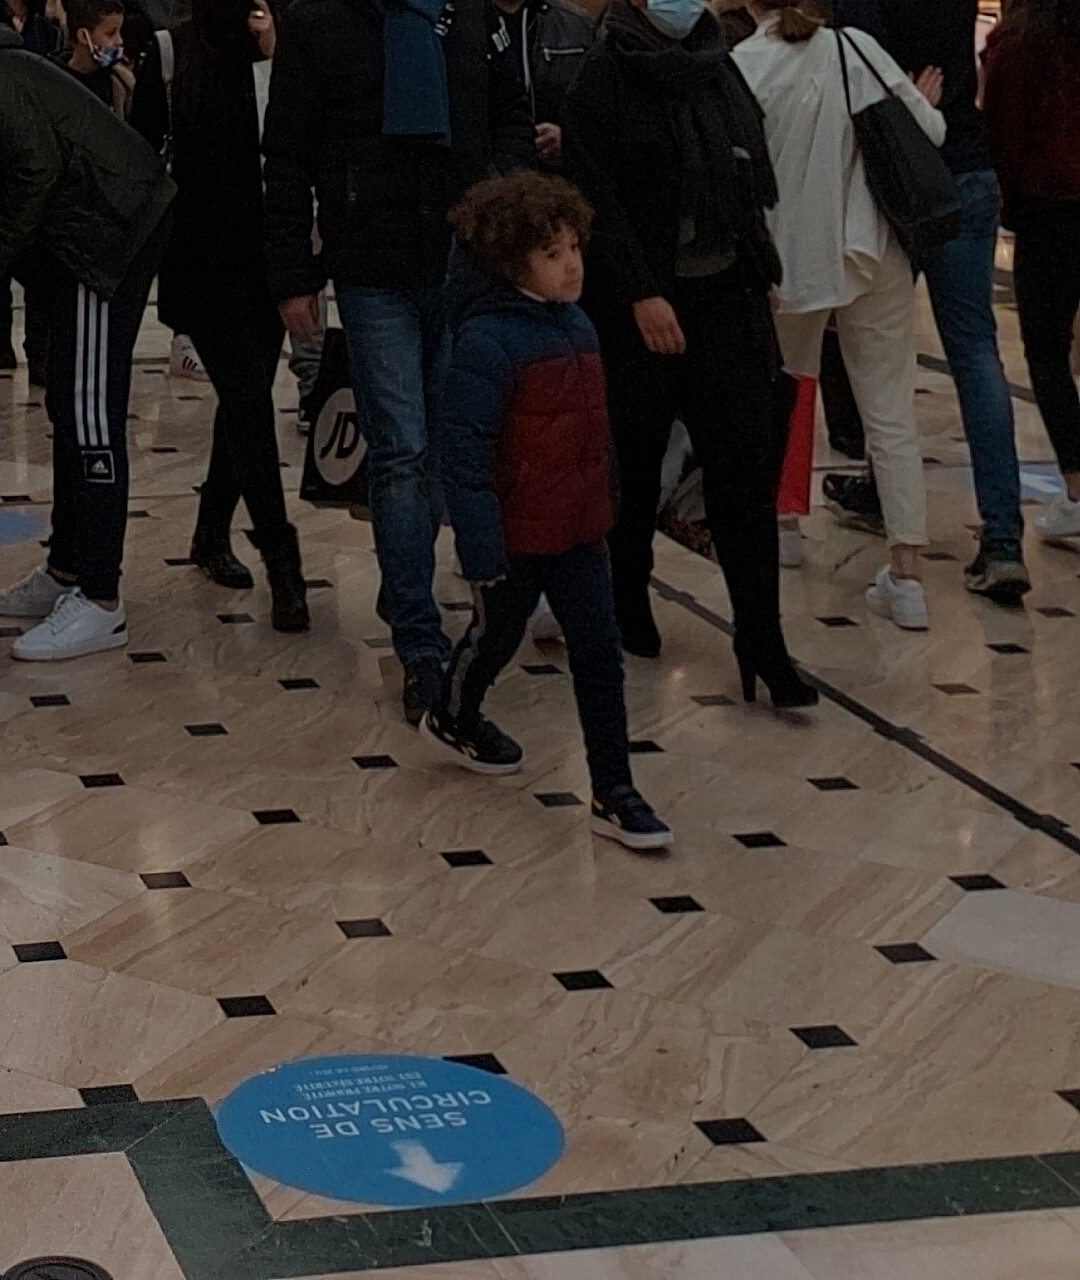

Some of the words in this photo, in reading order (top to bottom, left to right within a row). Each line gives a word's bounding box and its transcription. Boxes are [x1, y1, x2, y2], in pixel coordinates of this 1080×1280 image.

[319, 411, 360, 459] JD
[259, 1088, 493, 1123] CIRCULATION
[309, 1121, 360, 1139] DE
[370, 1111, 468, 1135] SENS
